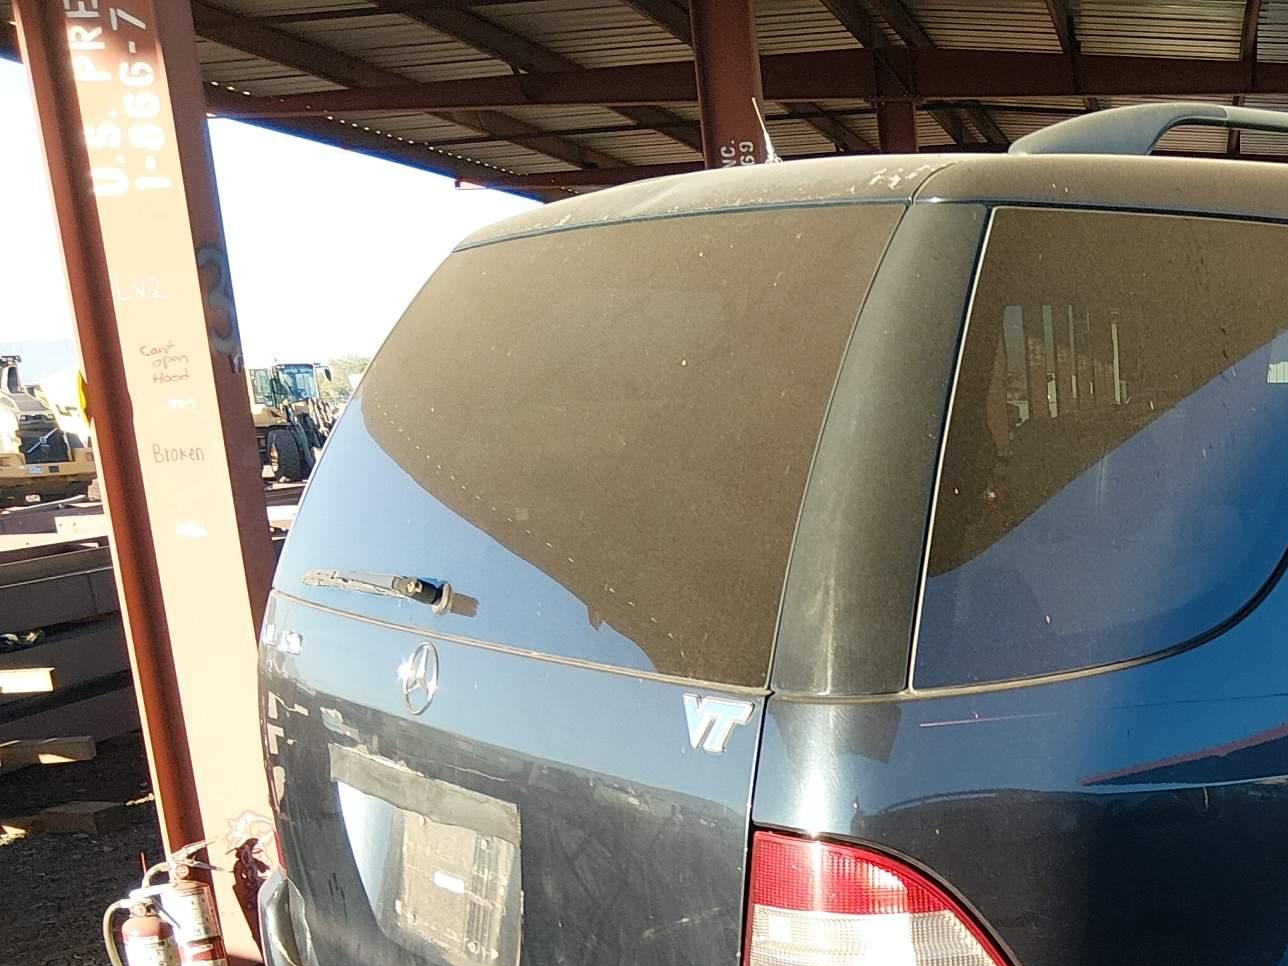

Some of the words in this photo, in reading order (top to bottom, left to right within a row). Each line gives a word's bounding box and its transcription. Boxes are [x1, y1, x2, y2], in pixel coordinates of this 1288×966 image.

[87, 108, 130, 197] U.S.
[152, 443, 205, 463] Broken
[682, 692, 755, 752] VT
